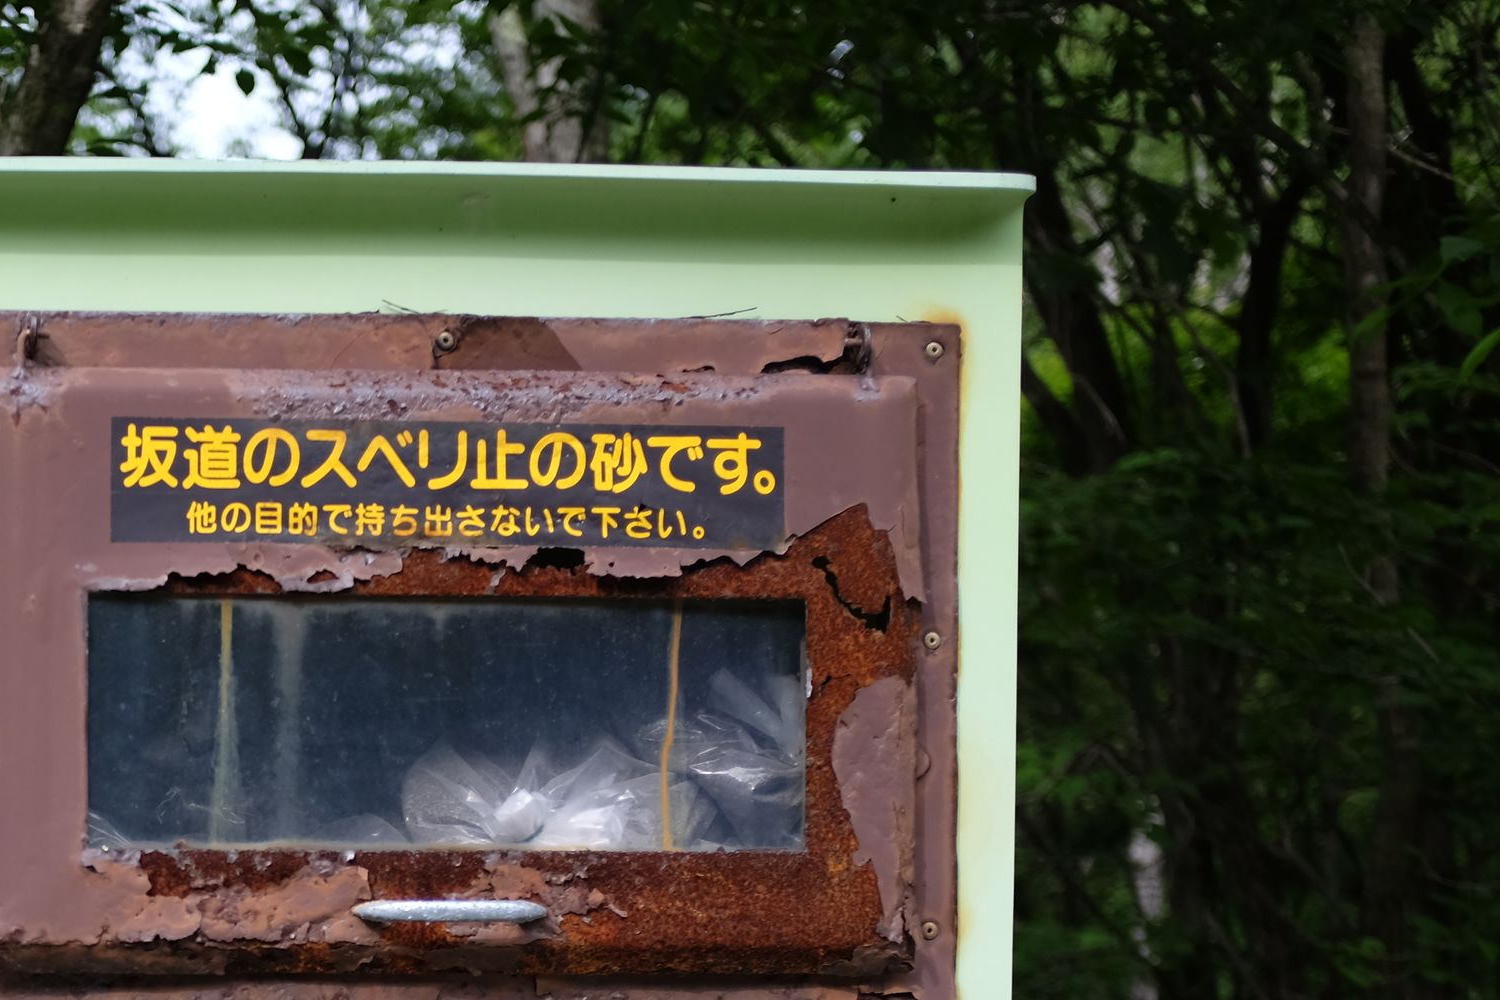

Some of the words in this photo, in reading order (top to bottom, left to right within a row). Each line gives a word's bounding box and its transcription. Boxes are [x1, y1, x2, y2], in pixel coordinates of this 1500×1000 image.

[119, 422, 776, 496] 坂道のスベリ止の砂です。
[185, 500, 705, 542] 他の目的で持ち出さないで下さい。
